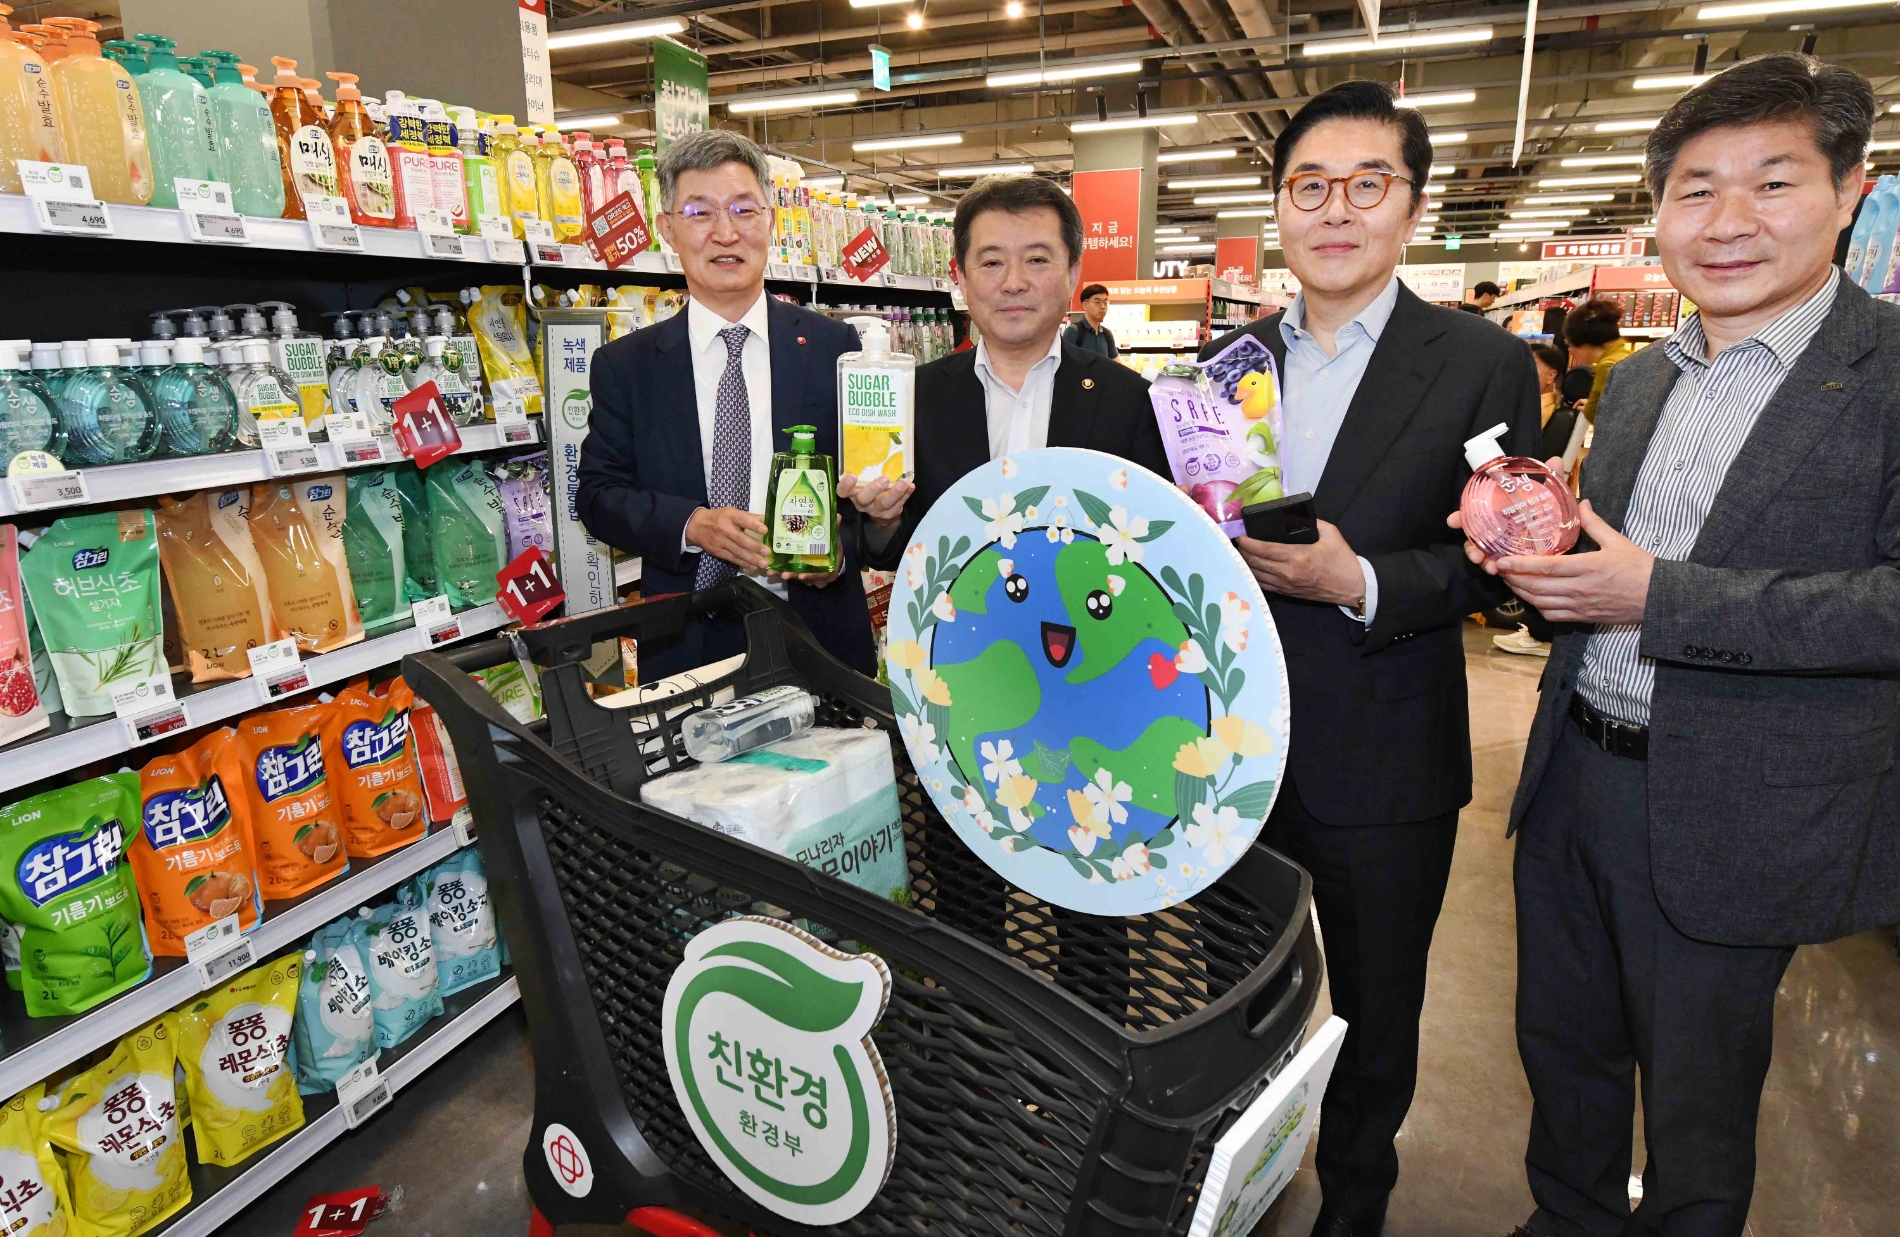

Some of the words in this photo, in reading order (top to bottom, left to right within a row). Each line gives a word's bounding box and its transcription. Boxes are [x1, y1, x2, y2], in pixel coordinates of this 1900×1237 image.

[403, 156, 430, 169] PURE
[483, 168, 496, 178] PU
[849, 236, 879, 267] NEW
[1643, 273, 1668, 282] 오늘
[1634, 294, 1645, 322] KANU
[1652, 294, 1664, 322] KANU
[285, 343, 318, 357] SUGAR
[563, 338, 586, 354] 녹색
[287, 356, 324, 371] BUBBLE
[563, 357, 587, 373] 제품
[197, 381, 219, 402] 순샘
[257, 383, 278, 392] SUGAR
[848, 373, 890, 391] SUGAR
[7, 391, 37, 415] 순샘
[110, 386, 136, 408] 순샘
[258, 391, 281, 400] BUBBLE
[848, 390, 897, 408] BUBBLE
[403, 397, 448, 446] 1+1
[567, 406, 587, 416] 친환경
[848, 408, 860, 416] ECO
[861, 408, 876, 417] DISH
[877, 409, 896, 418] WASH
[0, 420, 20, 429] 말라야
[30, 453, 46, 463] 녹색
[308, 488, 332, 501] 참그린
[789, 496, 816, 509] 자연퐁
[74, 551, 108, 570] 참그린
[53, 571, 142, 599] 허브식초
[507, 560, 552, 607] 1+1
[206, 662, 225, 670] LION
[350, 698, 370, 708] LION
[494, 681, 526, 706] URE
[253, 726, 268, 734] LION
[347, 713, 410, 765] 참그린
[150, 767, 175, 777] LION
[262, 740, 323, 797] 참그린
[358, 768, 396, 789] 기름기
[149, 781, 227, 844] 참그린
[277, 799, 318, 822] 기름기
[318, 797, 332, 810] 뽀드
[12, 810, 41, 827] LION
[165, 848, 214, 873] 기름기
[214, 839, 242, 862] 뽀드득
[796, 832, 845, 866] 모나리자
[813, 824, 893, 878] 무이야기
[25, 826, 123, 900] 참그린
[105, 887, 130, 909] 뽀드득
[438, 878, 466, 905] 퐁퐁
[51, 895, 103, 927] 기름기
[387, 916, 419, 944] 퐁퐁
[377, 936, 432, 969] 베이킹소
[327, 975, 369, 1014] 베이킹소
[228, 1012, 267, 1047] 퐁퐁
[219, 1034, 289, 1074] 레몬식초
[708, 1030, 828, 1130] 친환경
[102, 1083, 146, 1125] 퐁퐁
[98, 1101, 176, 1155] 레몬식초
[738, 1110, 804, 1157] 환경부
[308, 1196, 368, 1229] 1+1
